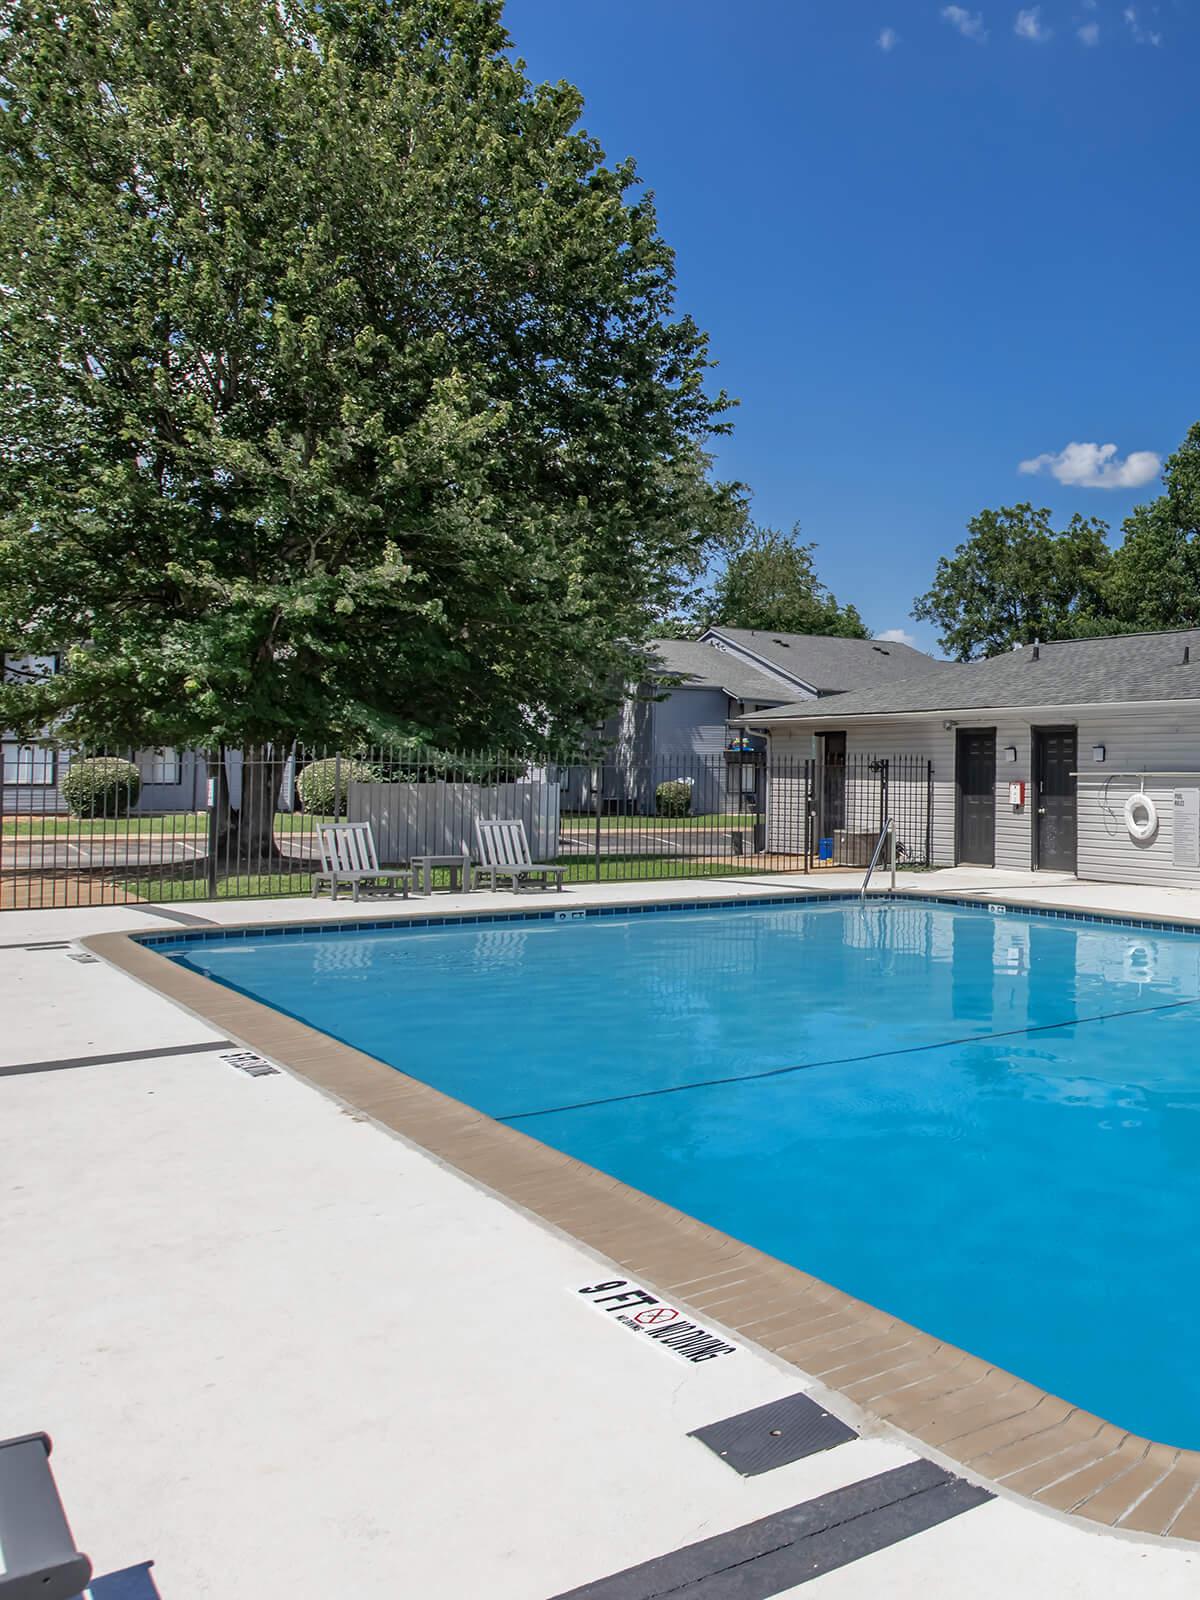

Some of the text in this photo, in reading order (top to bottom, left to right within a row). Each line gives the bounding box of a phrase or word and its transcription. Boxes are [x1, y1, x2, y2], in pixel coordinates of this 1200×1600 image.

[578, 1280, 660, 1312] 9 FT
[644, 1320, 737, 1363] NO DIVING
